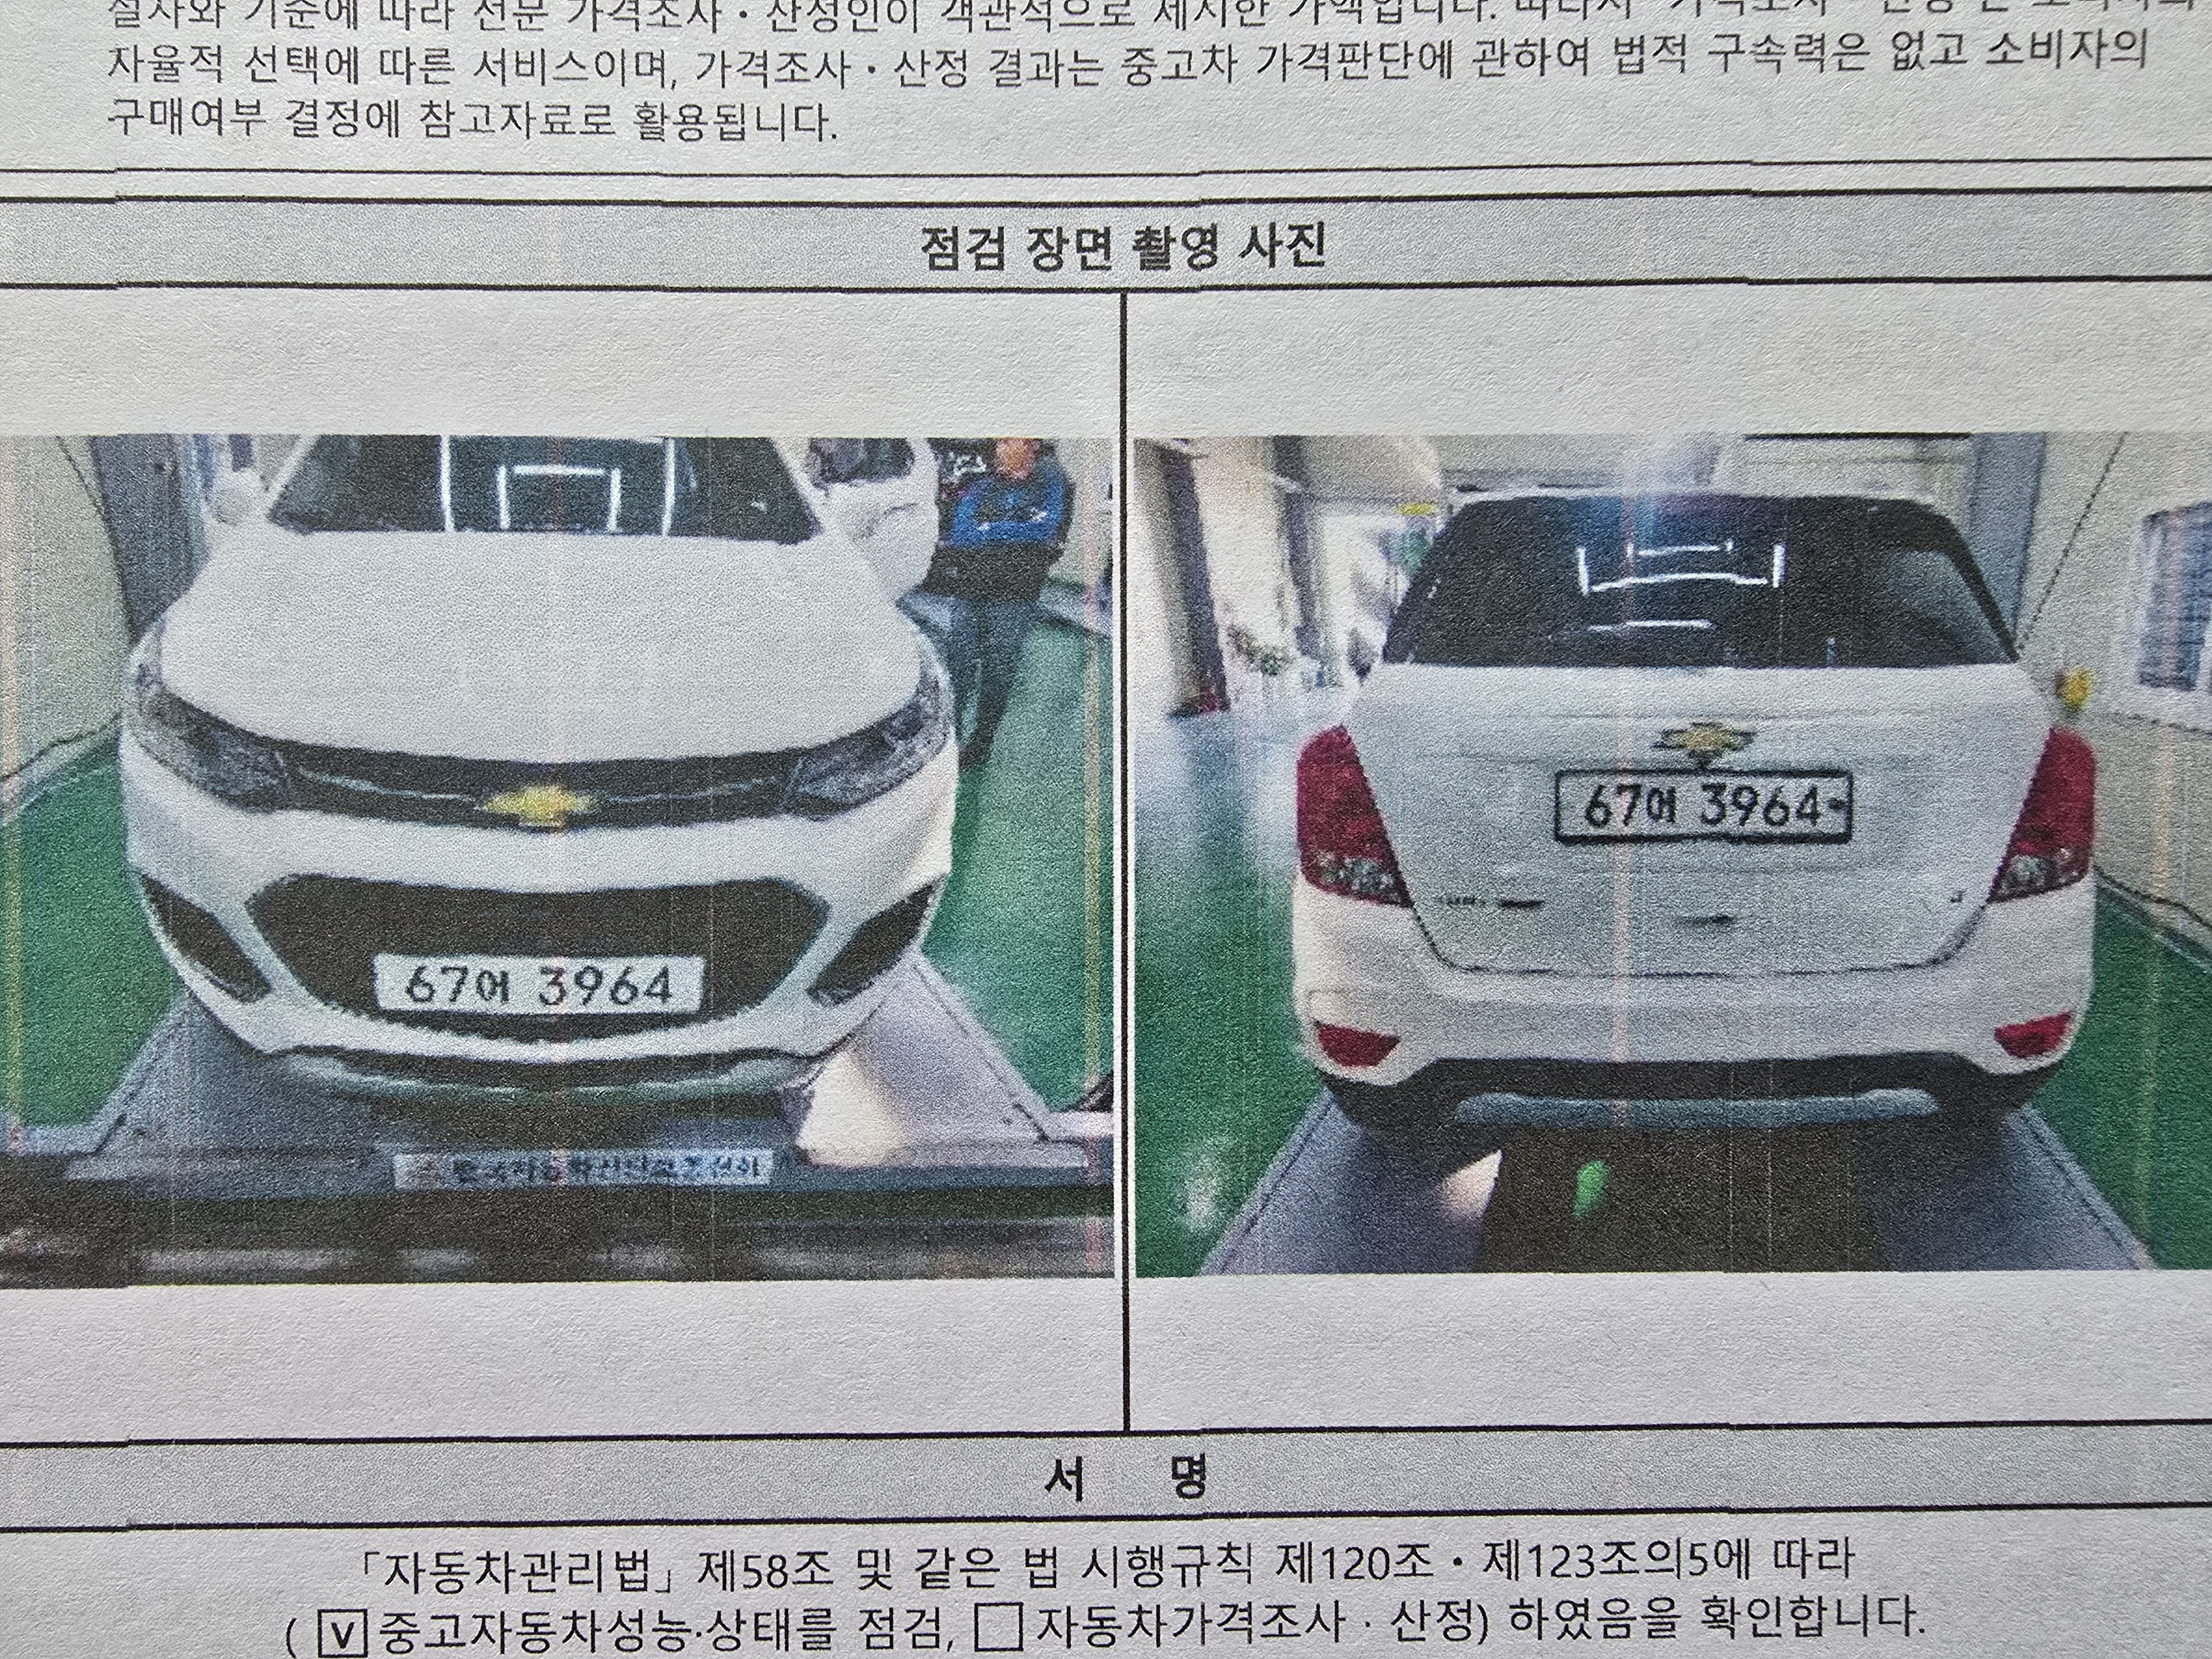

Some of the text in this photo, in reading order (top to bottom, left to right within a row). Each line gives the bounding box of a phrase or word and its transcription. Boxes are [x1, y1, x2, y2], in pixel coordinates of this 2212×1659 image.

[107, 44, 223, 84] 자율적
[244, 45, 359, 85] 선택에
[379, 46, 455, 86] 따른
[473, 47, 677, 91] 서비스이며,
[989, 48, 1104, 88] 결과는
[1121, 43, 1238, 87] 중고차
[1256, 39, 1453, 83] 가격판단에
[1472, 36, 1589, 79] 관하여
[1614, 33, 1687, 76] 법적
[1708, 33, 1871, 75] 구속력은
[1891, 30, 1969, 72] 없고
[1985, 28, 2147, 70] 소비자의
[107, 97, 837, 143] 구매여부 결정에 참고자료로 활용됩니다.
[921, 221, 1326, 273] 점검 장면 촬영 사진
[1700, 782, 1822, 827] 3964
[538, 965, 672, 1006] 3964
[1044, 1452, 1206, 1502] 서 명
[697, 1549, 834, 1593] 제58조
[857, 1548, 893, 1591] 및
[914, 1547, 1000, 1590] 같은
[1025, 1546, 1057, 1589] 법
[1081, 1541, 1252, 1589] 시행규칙
[1275, 1541, 1434, 1584] 제120조
[1482, 1536, 1750, 1582] 제123조의5에
[1773, 1536, 1856, 1580] 따라
[858, 1606, 954, 1653] 점검,
[1509, 1596, 1682, 1641] 하였음을
[1700, 1594, 1926, 1640] 확인합니다.
